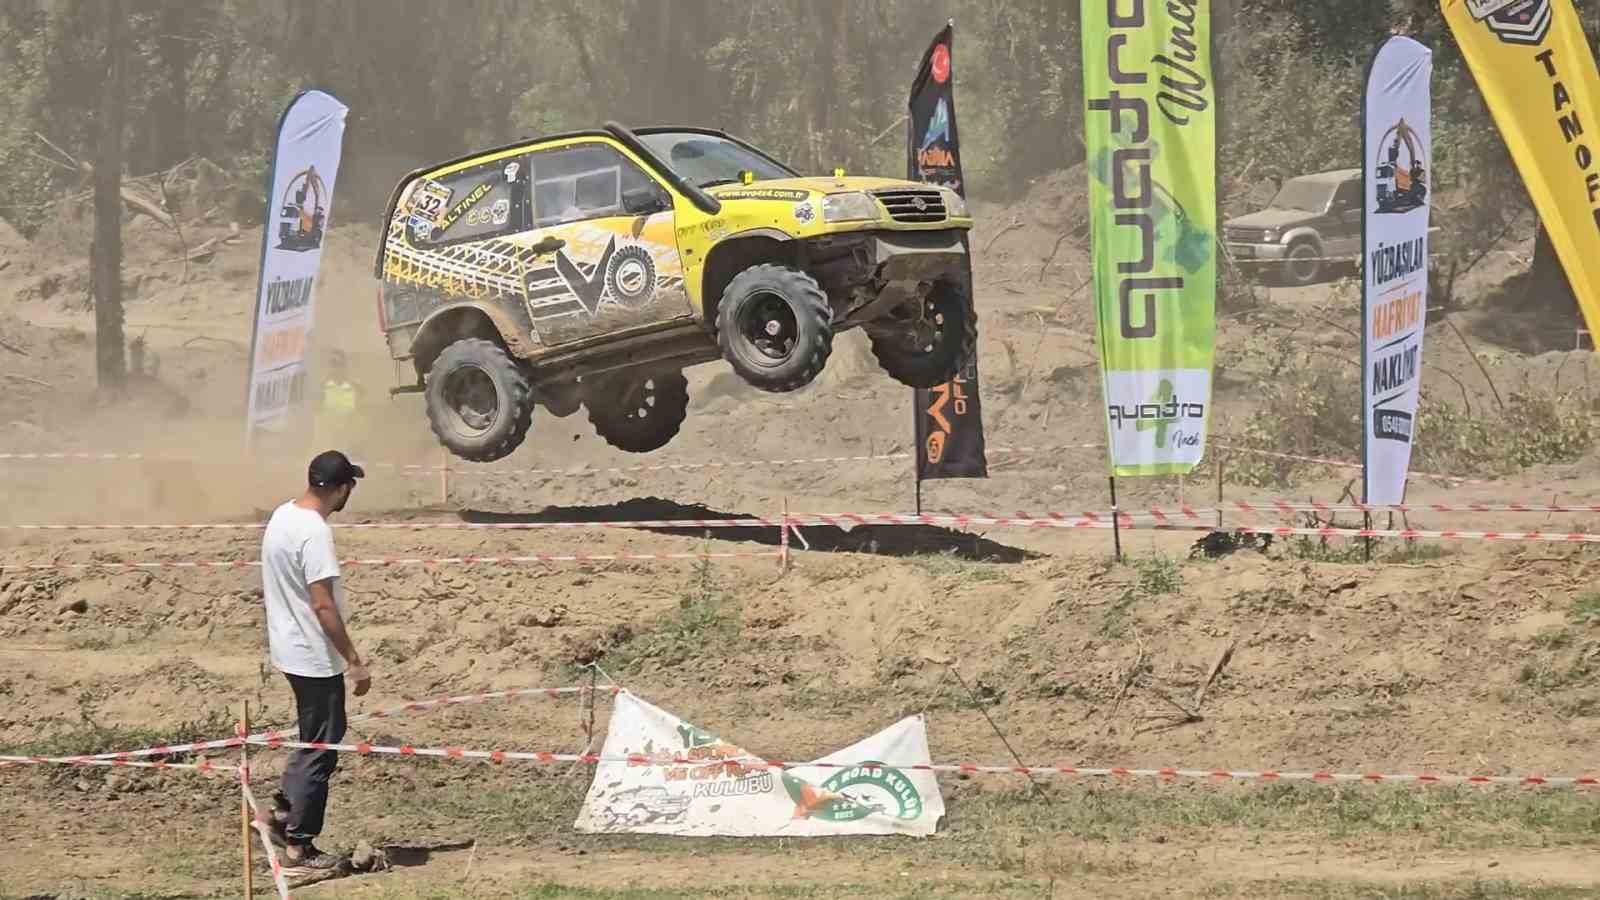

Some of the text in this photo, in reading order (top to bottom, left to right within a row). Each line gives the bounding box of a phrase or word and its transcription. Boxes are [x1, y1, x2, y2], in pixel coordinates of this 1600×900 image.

[420, 194, 442, 214] 32
[1371, 236, 1423, 287] YÜZBAŞILAR
[1108, 394, 1204, 431] quatro
